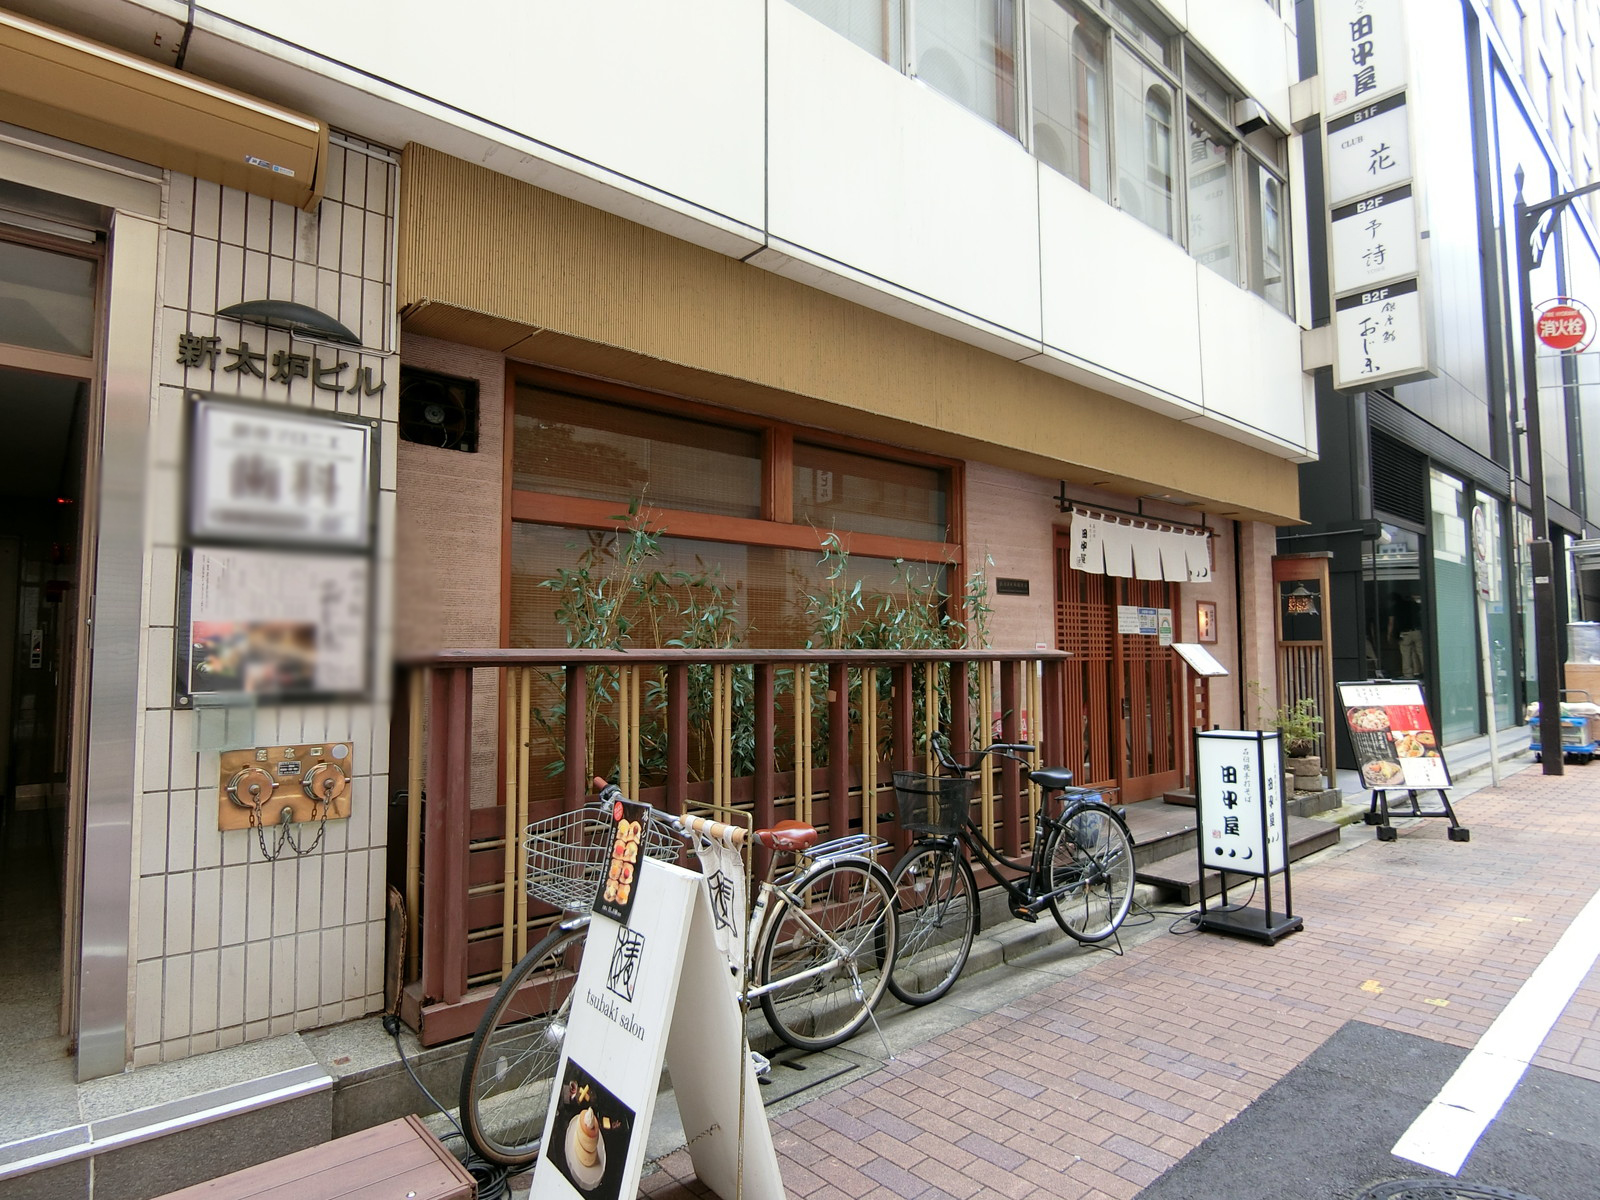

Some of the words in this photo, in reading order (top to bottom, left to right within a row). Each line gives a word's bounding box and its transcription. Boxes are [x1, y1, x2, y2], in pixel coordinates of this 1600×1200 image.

[1349, 14, 1377, 97] 田中屋
[1353, 105, 1378, 122] B1F
[1341, 135, 1364, 150] CLUB
[1367, 143, 1396, 175] 花
[1356, 196, 1384, 213] B2F
[1361, 288, 1389, 305] B2F
[1540, 318, 1584, 337] 消火栓
[177, 332, 387, 396] 新太炉ビル
[1220, 765, 1240, 836] 田中屋
[587, 988, 619, 1022] tsubaki
[619, 1013, 645, 1041] salon
